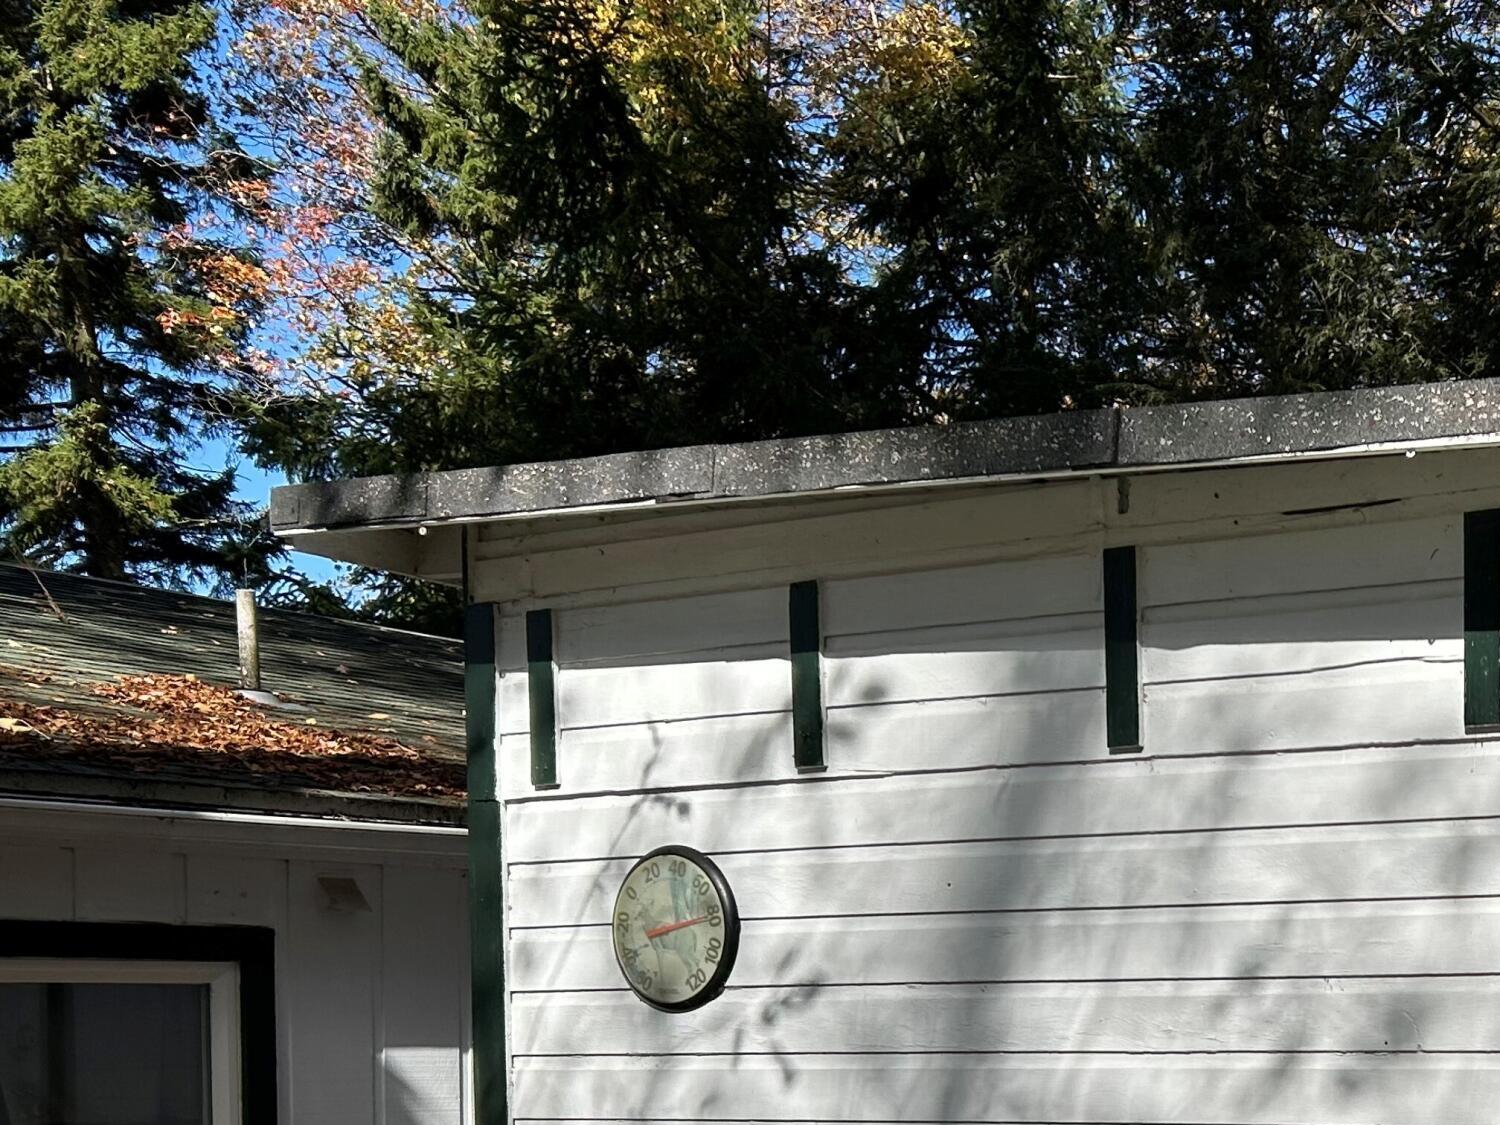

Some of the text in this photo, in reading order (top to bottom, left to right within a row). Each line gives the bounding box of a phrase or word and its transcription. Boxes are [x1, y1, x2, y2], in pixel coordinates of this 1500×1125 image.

[642, 862, 660, 883] 20
[669, 860, 686, 877] 40
[626, 886, 637, 900] 0
[692, 874, 710, 895] 60
[707, 904, 722, 927] 80
[705, 938, 721, 964] 100
[686, 968, 706, 992] 120
